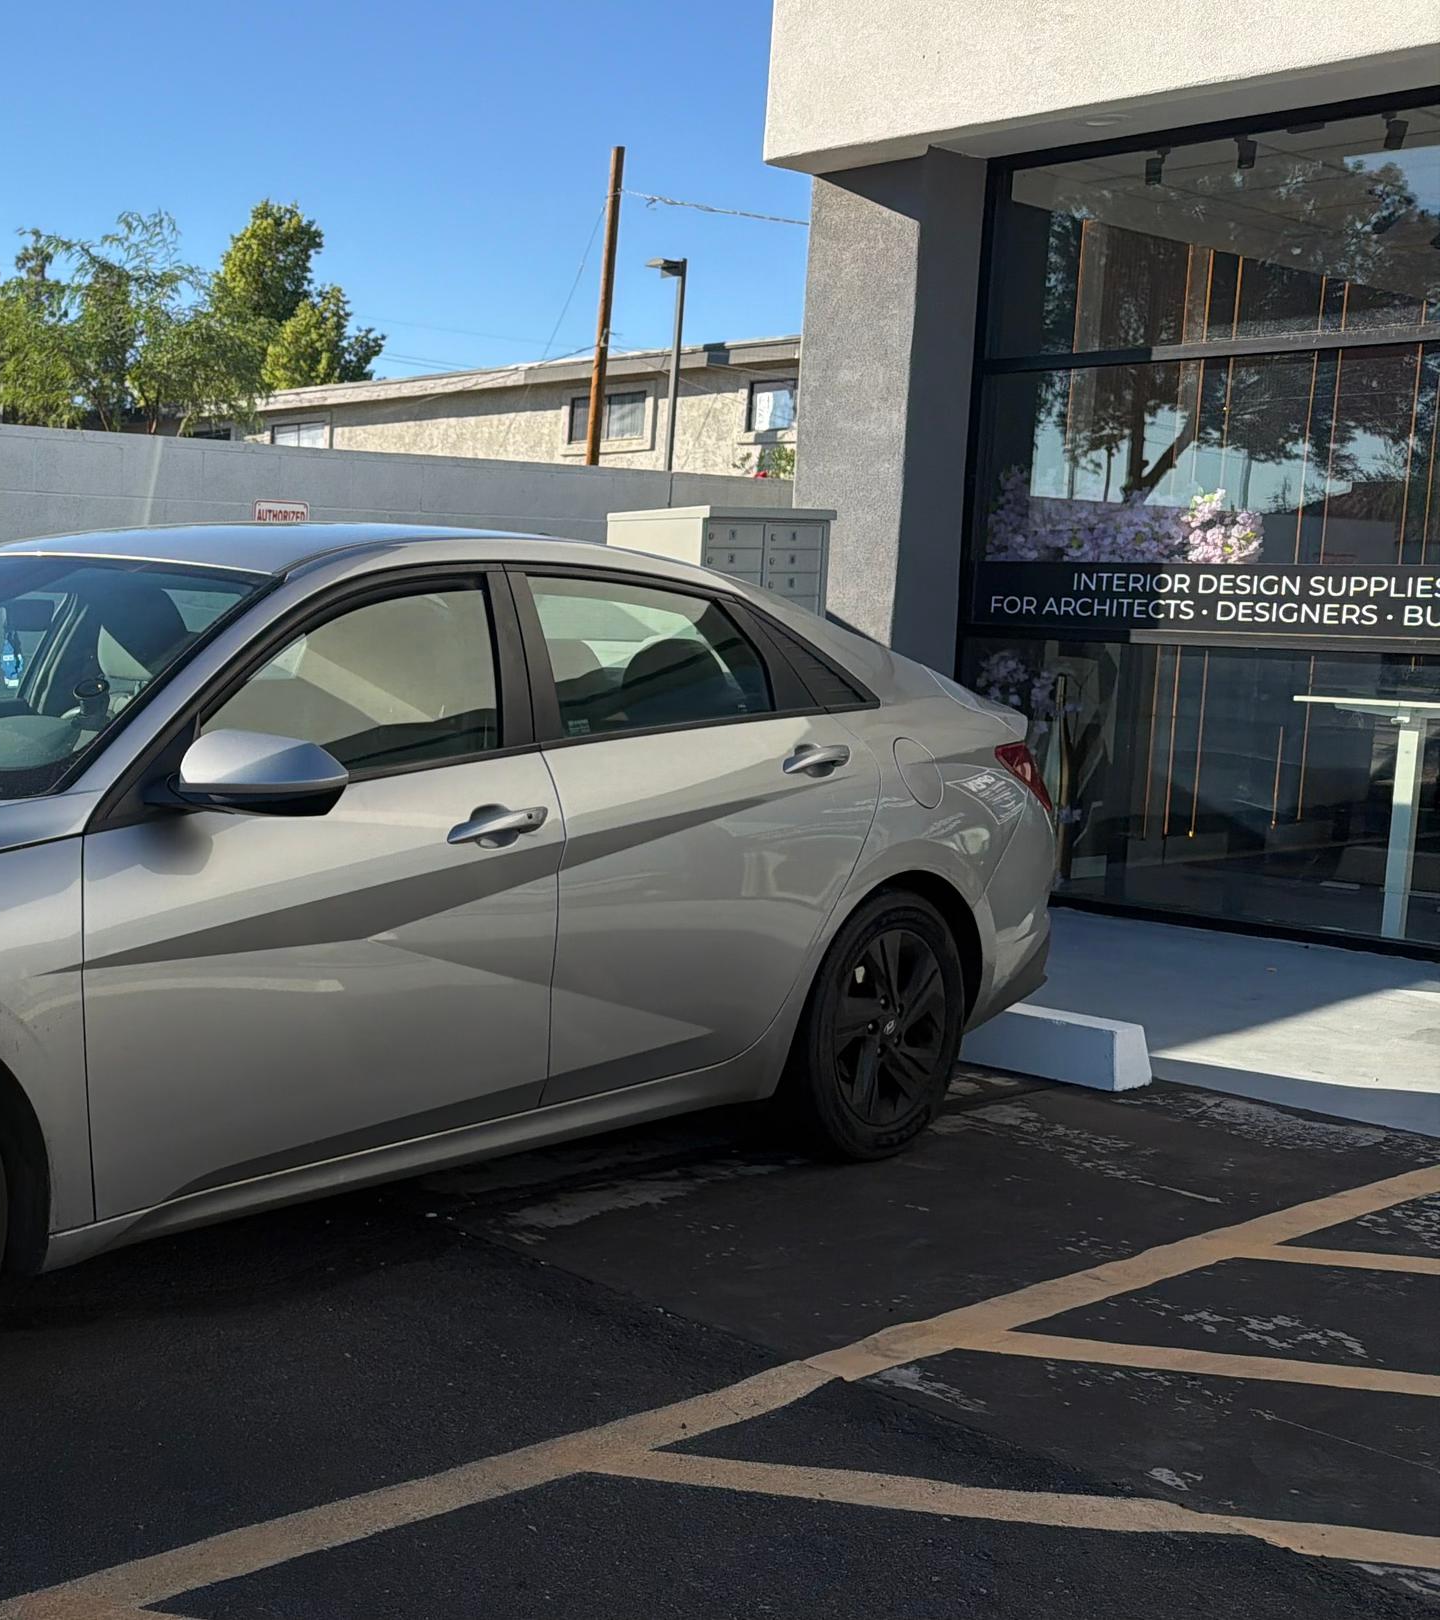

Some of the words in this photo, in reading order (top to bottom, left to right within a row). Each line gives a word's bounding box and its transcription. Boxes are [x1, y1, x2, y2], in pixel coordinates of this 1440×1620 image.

[257, 509, 305, 521] AUTHORIZED
[1072, 572, 1190, 594] INTERIOR
[1198, 574, 1301, 596] DESIGN
[990, 595, 1037, 615] FOR
[1042, 597, 1195, 621] ARCHITECTS
[1216, 602, 1378, 626] DESIGNERS
